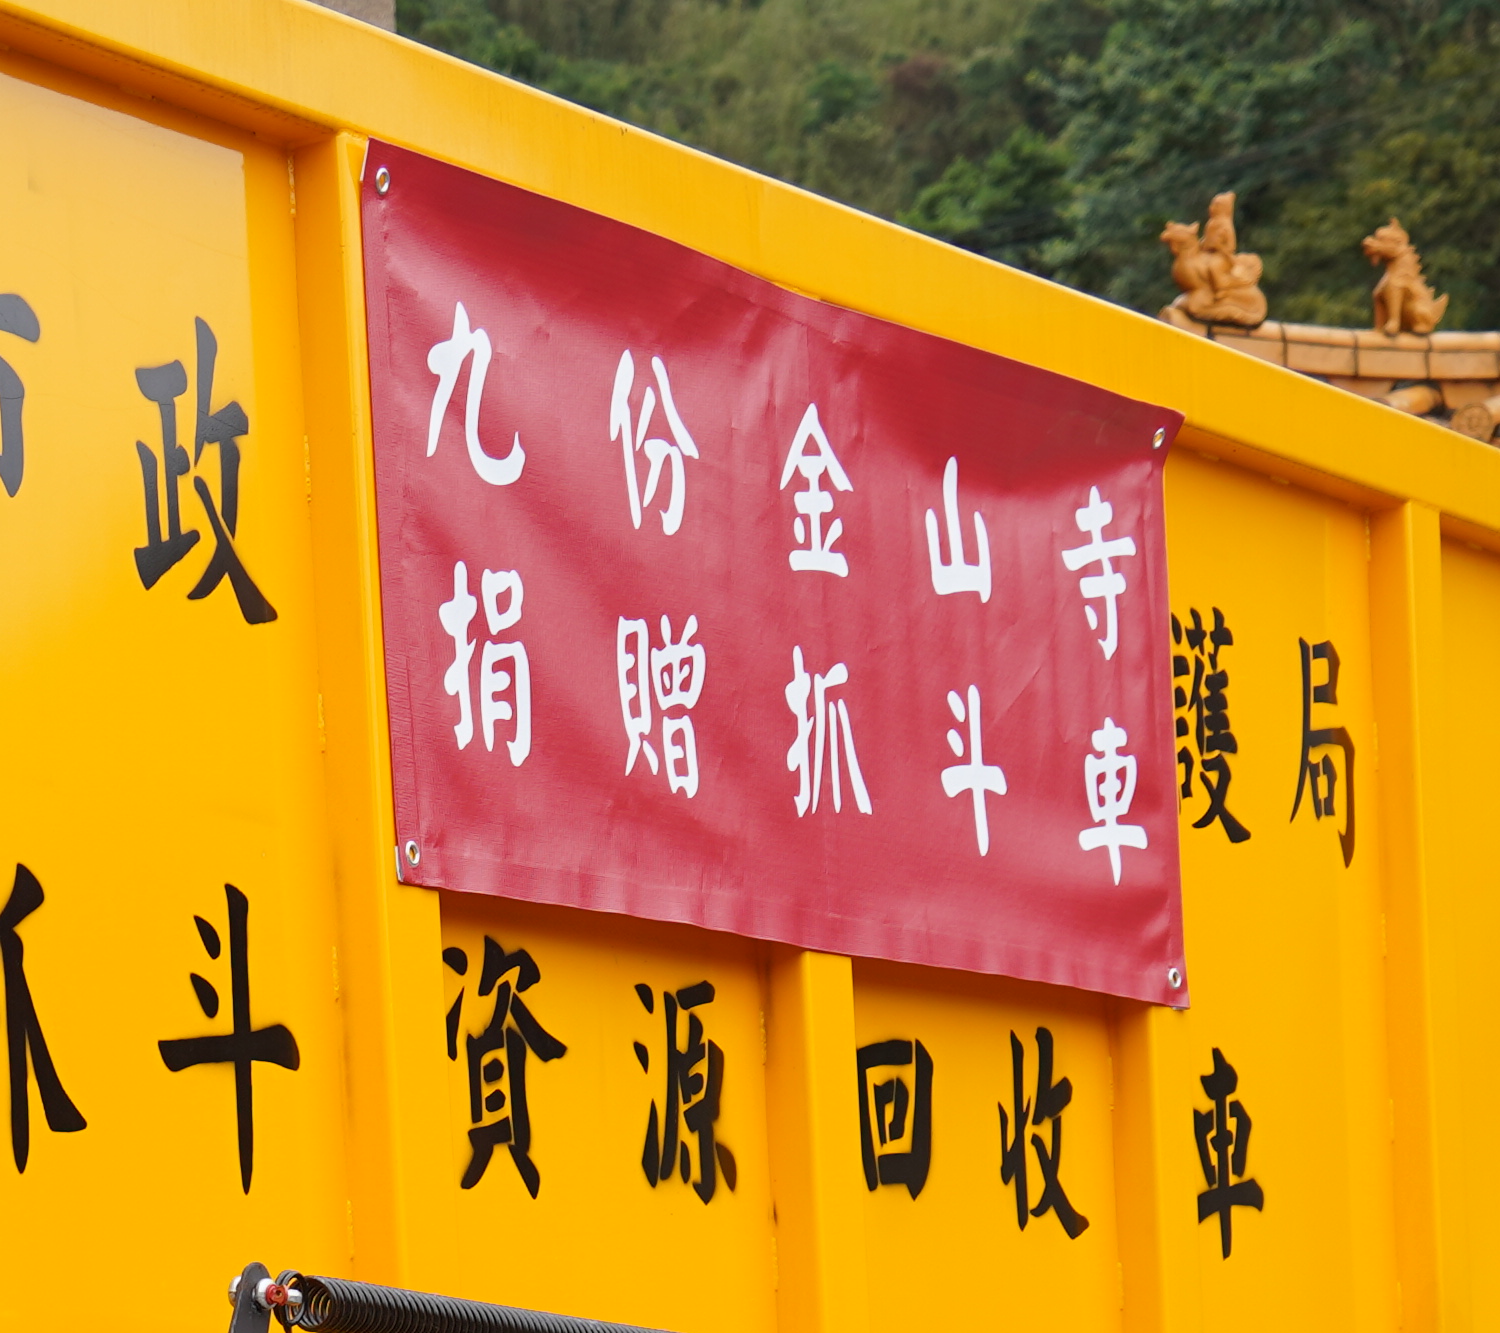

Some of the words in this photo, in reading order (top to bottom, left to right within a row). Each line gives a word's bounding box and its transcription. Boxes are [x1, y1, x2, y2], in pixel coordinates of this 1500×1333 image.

[426, 300, 1138, 661] 九份金山寺
[438, 560, 1148, 886] 捐贈抓斗車
